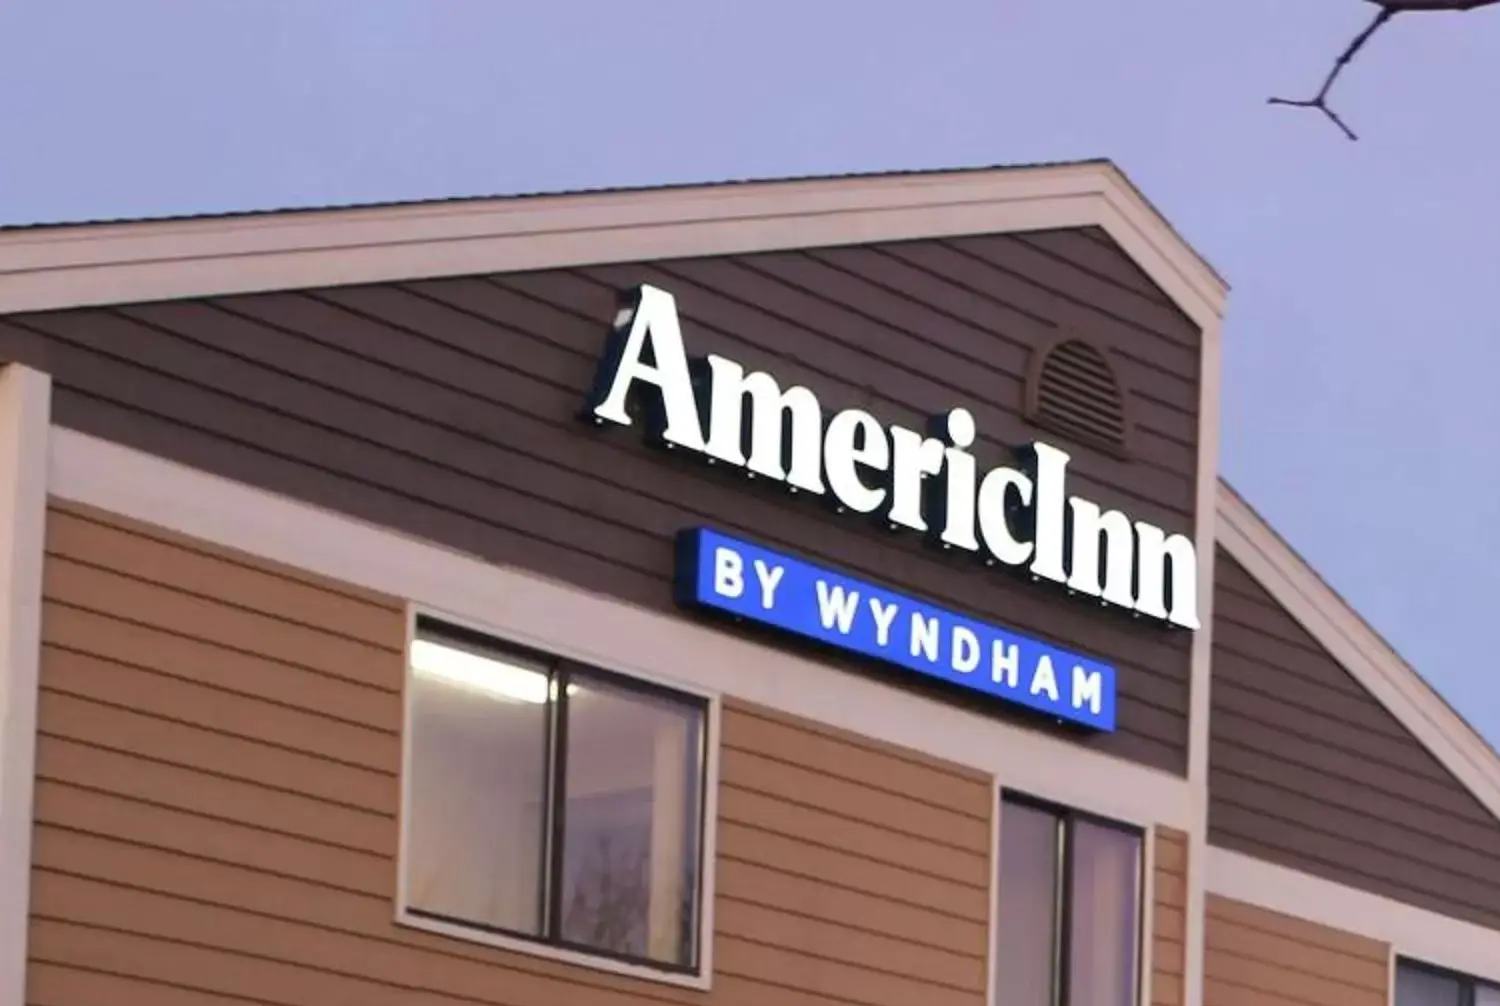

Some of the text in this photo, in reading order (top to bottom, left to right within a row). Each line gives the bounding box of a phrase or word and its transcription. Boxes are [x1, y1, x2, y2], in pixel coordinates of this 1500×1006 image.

[594, 284, 1200, 630] AmericInn
[713, 547, 1102, 716] BY WYNDHAM
